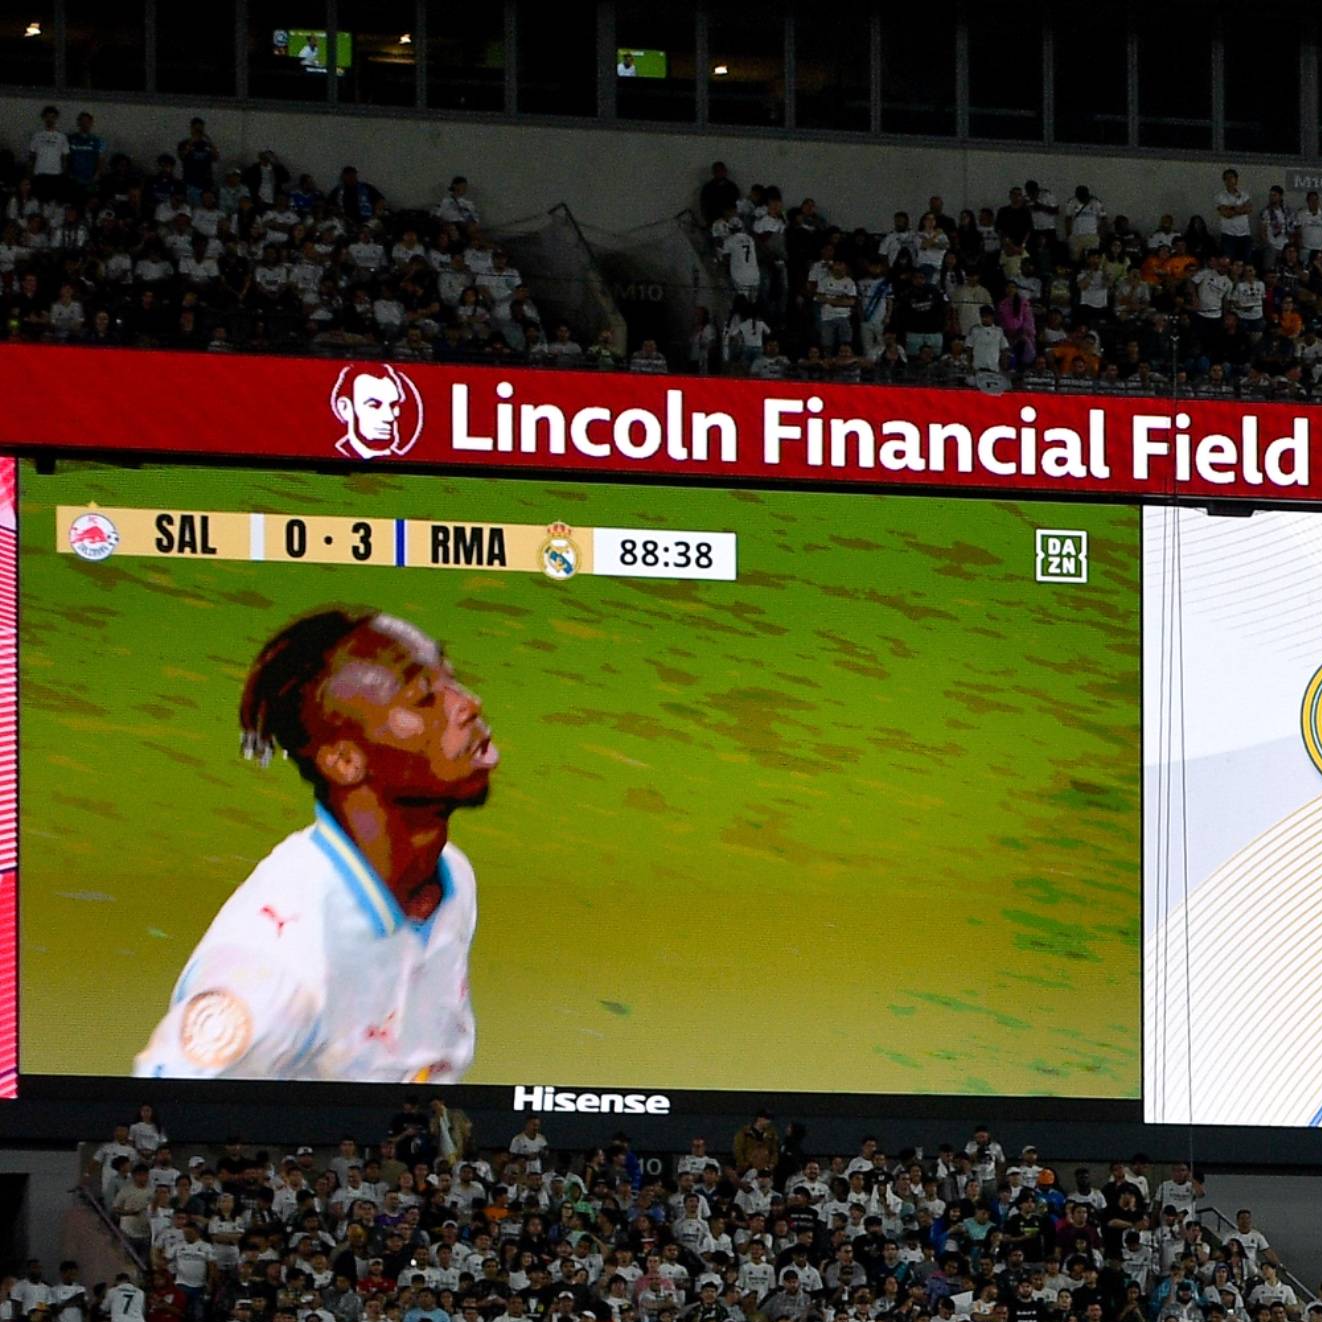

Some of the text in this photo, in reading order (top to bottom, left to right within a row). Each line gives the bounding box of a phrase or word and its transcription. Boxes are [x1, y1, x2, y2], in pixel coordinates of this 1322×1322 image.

[451, 381, 1311, 486] Lincoln Financial Field
[155, 513, 714, 571] SAL 0 3 RMA 88:38
[1047, 538, 1076, 556] DA
[1047, 558, 1076, 575] ZN
[513, 1085, 671, 1115] Hisense
[121, 1295, 133, 1315] 7
